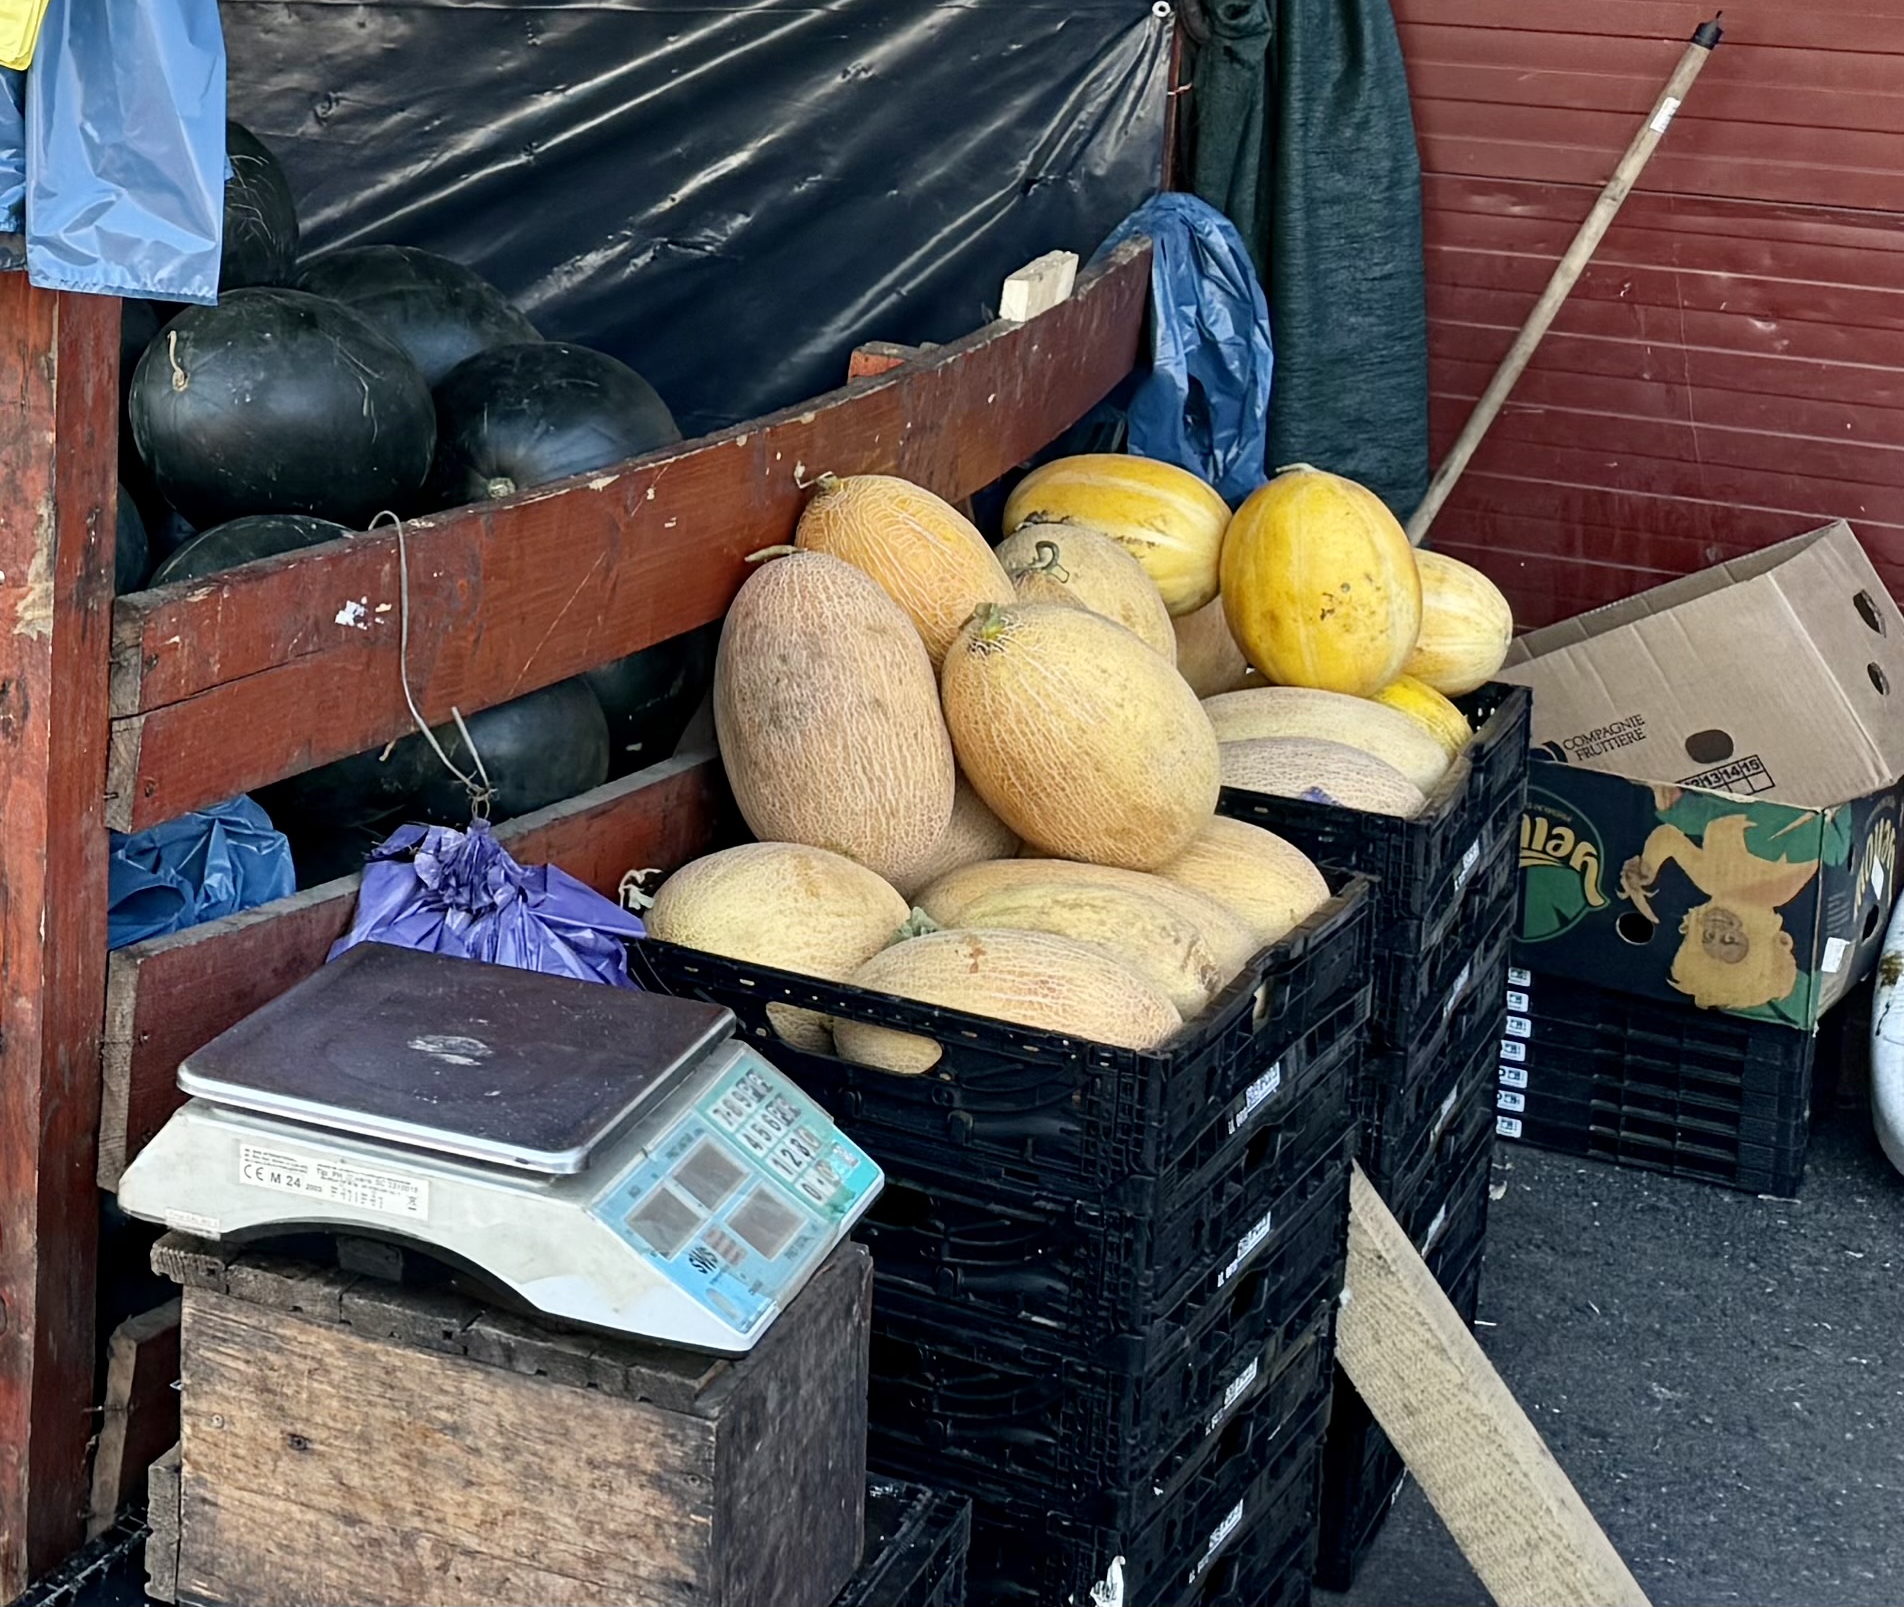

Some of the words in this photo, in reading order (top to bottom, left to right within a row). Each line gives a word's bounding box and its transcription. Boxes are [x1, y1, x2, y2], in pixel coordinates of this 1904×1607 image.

[1562, 713, 1646, 751] COMPAGNIE
[1703, 772, 1722, 786] 13
[1721, 765, 1741, 780] 14
[1741, 758, 1761, 773] 15
[270, 1172, 282, 1185] M
[285, 1175, 301, 1188] 24
